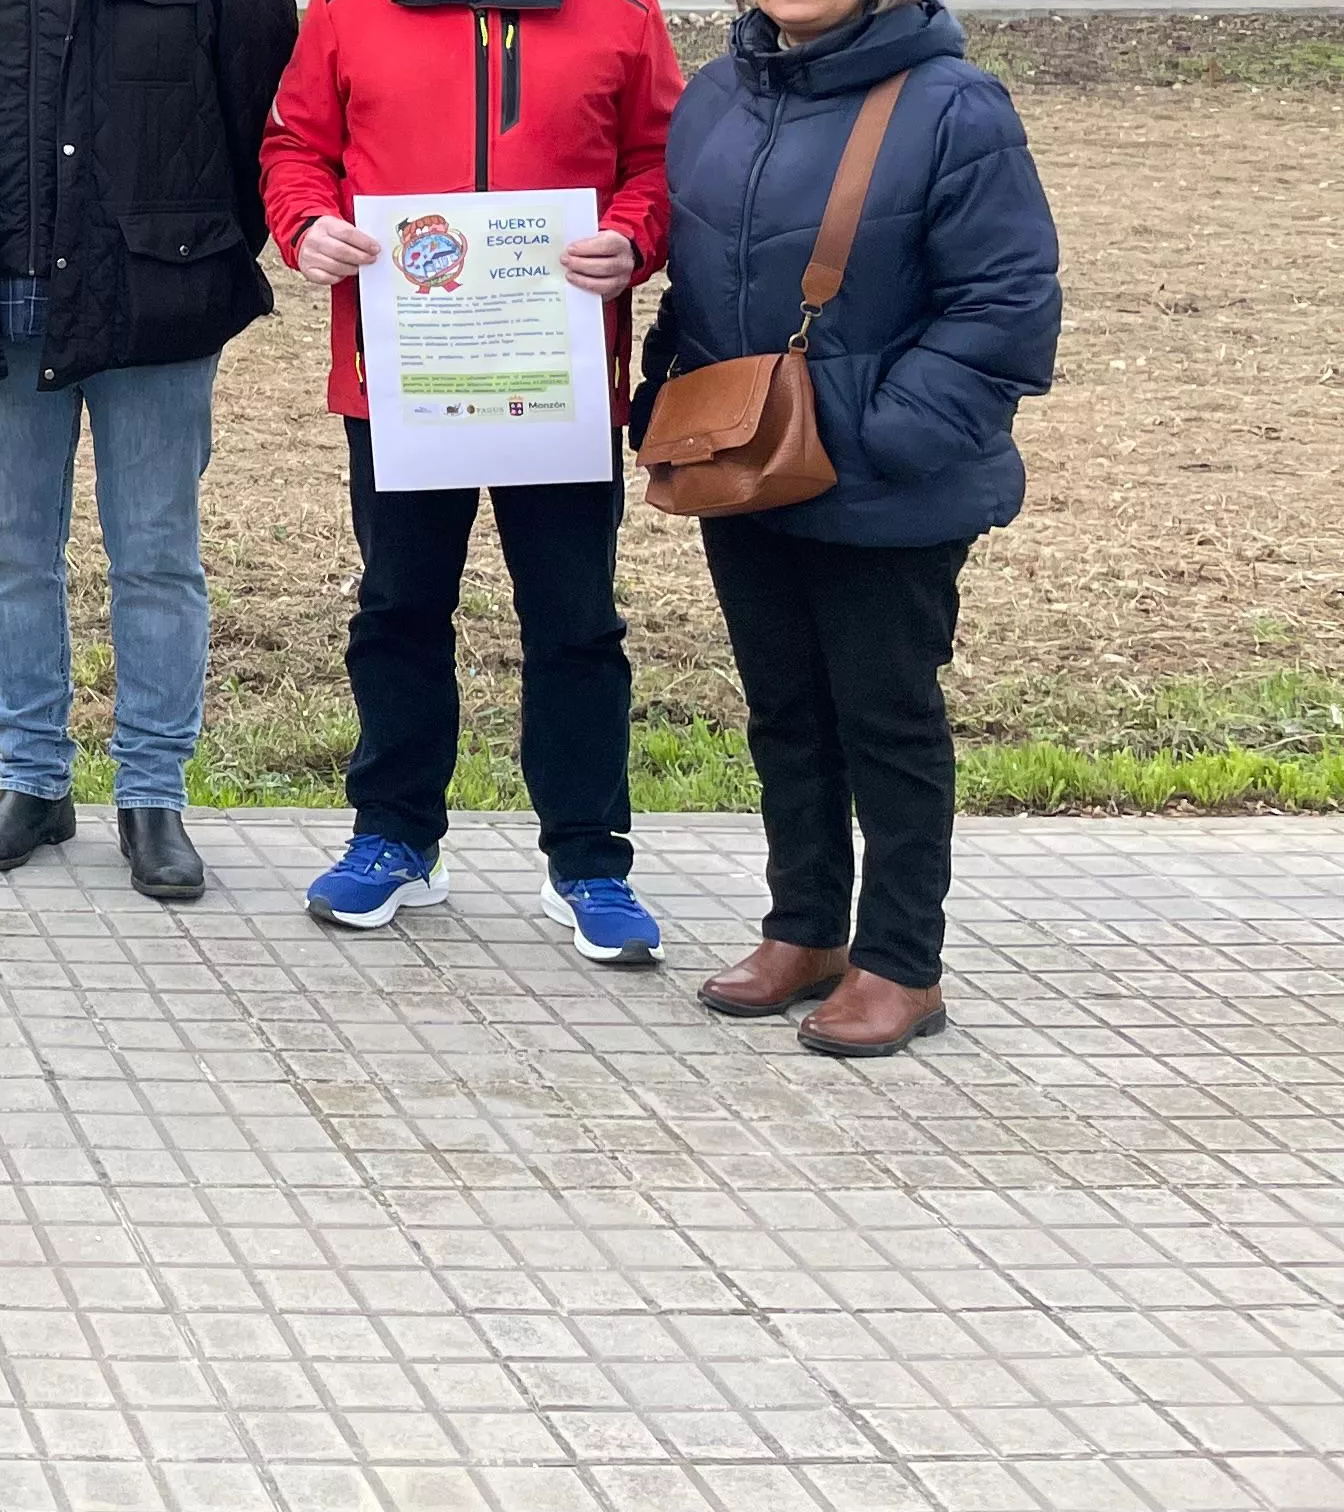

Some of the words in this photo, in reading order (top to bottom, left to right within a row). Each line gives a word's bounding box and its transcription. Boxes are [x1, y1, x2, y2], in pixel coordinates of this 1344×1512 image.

[488, 218, 547, 230] HUERTO
[486, 235, 550, 247] ESCOLAR
[489, 265, 551, 279] VECINAL
[528, 401, 566, 409] Monzón
